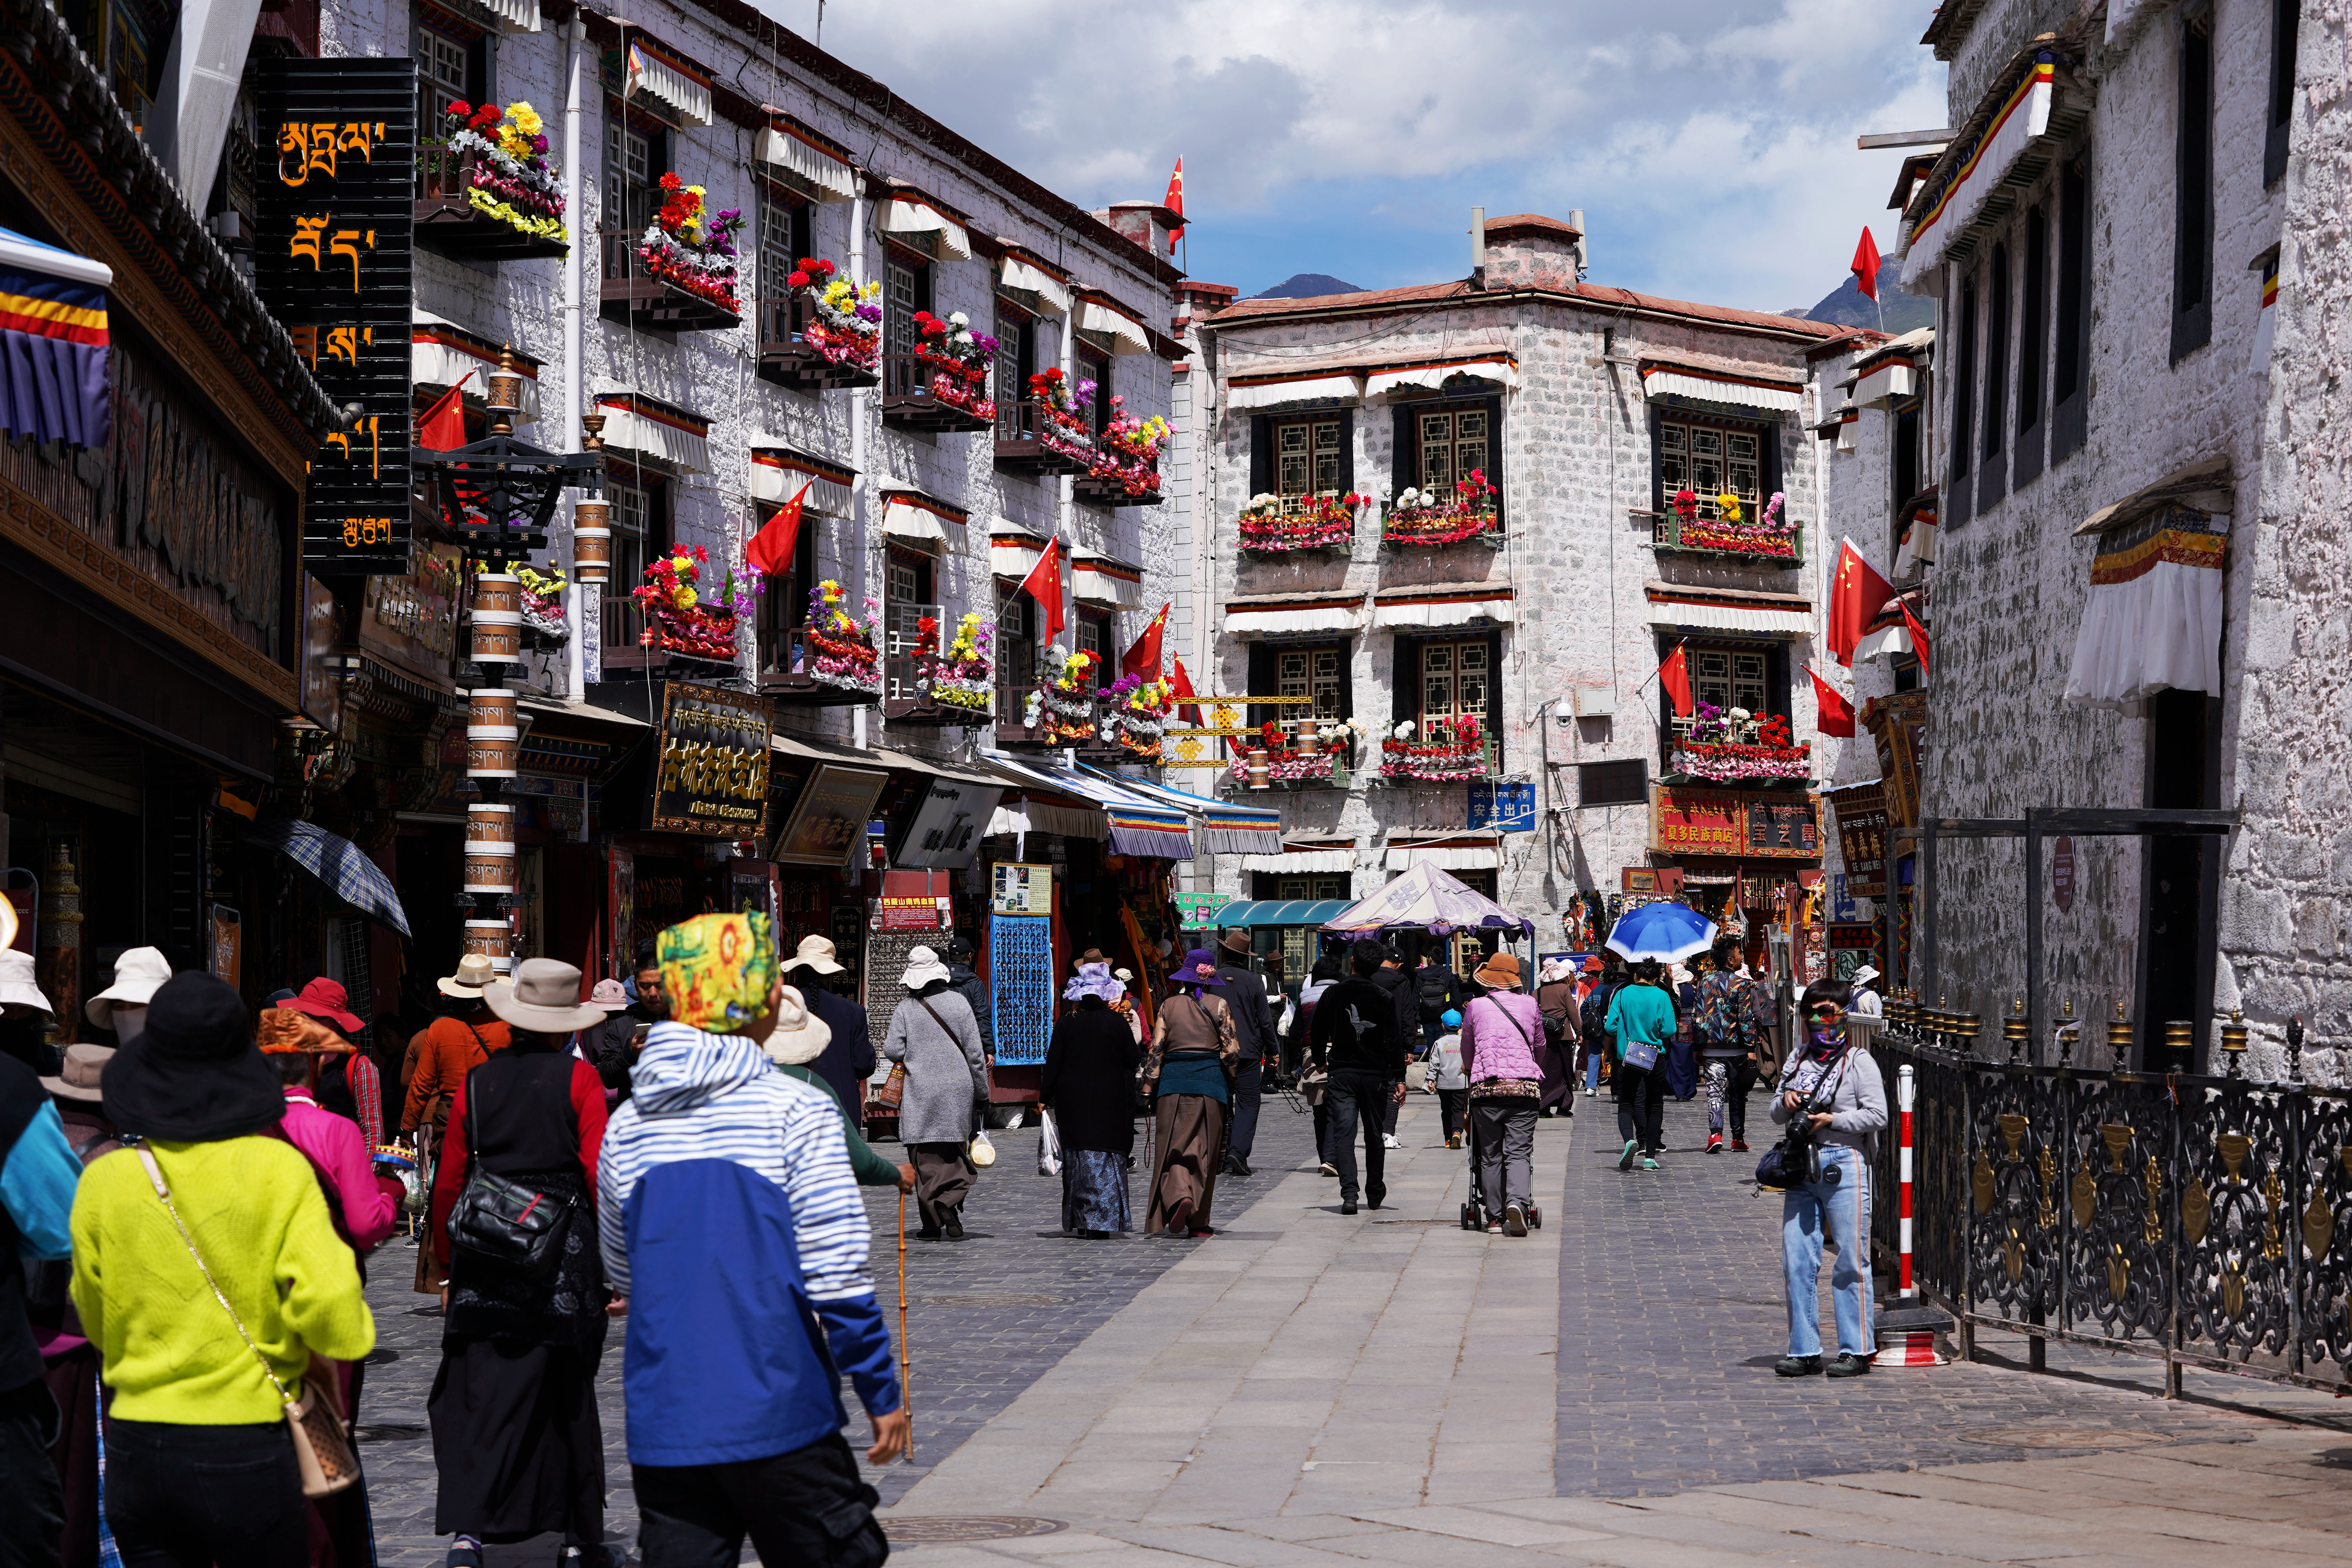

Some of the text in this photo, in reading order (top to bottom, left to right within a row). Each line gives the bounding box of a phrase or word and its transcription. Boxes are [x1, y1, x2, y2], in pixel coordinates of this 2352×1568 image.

[290, 212, 375, 294] བོད་
[1474, 803, 1530, 817] 安全出口
[1667, 825, 1733, 843] 夏多民族商店
[1845, 830, 1886, 861] 格桑梅
[1852, 862, 1858, 872] GE
[1860, 861, 1872, 872] SANG
[883, 897, 936, 906] 西藏山南鸡血藤
[1183, 896, 1227, 905] 萬順牙科
[837, 925, 856, 933] 专营
